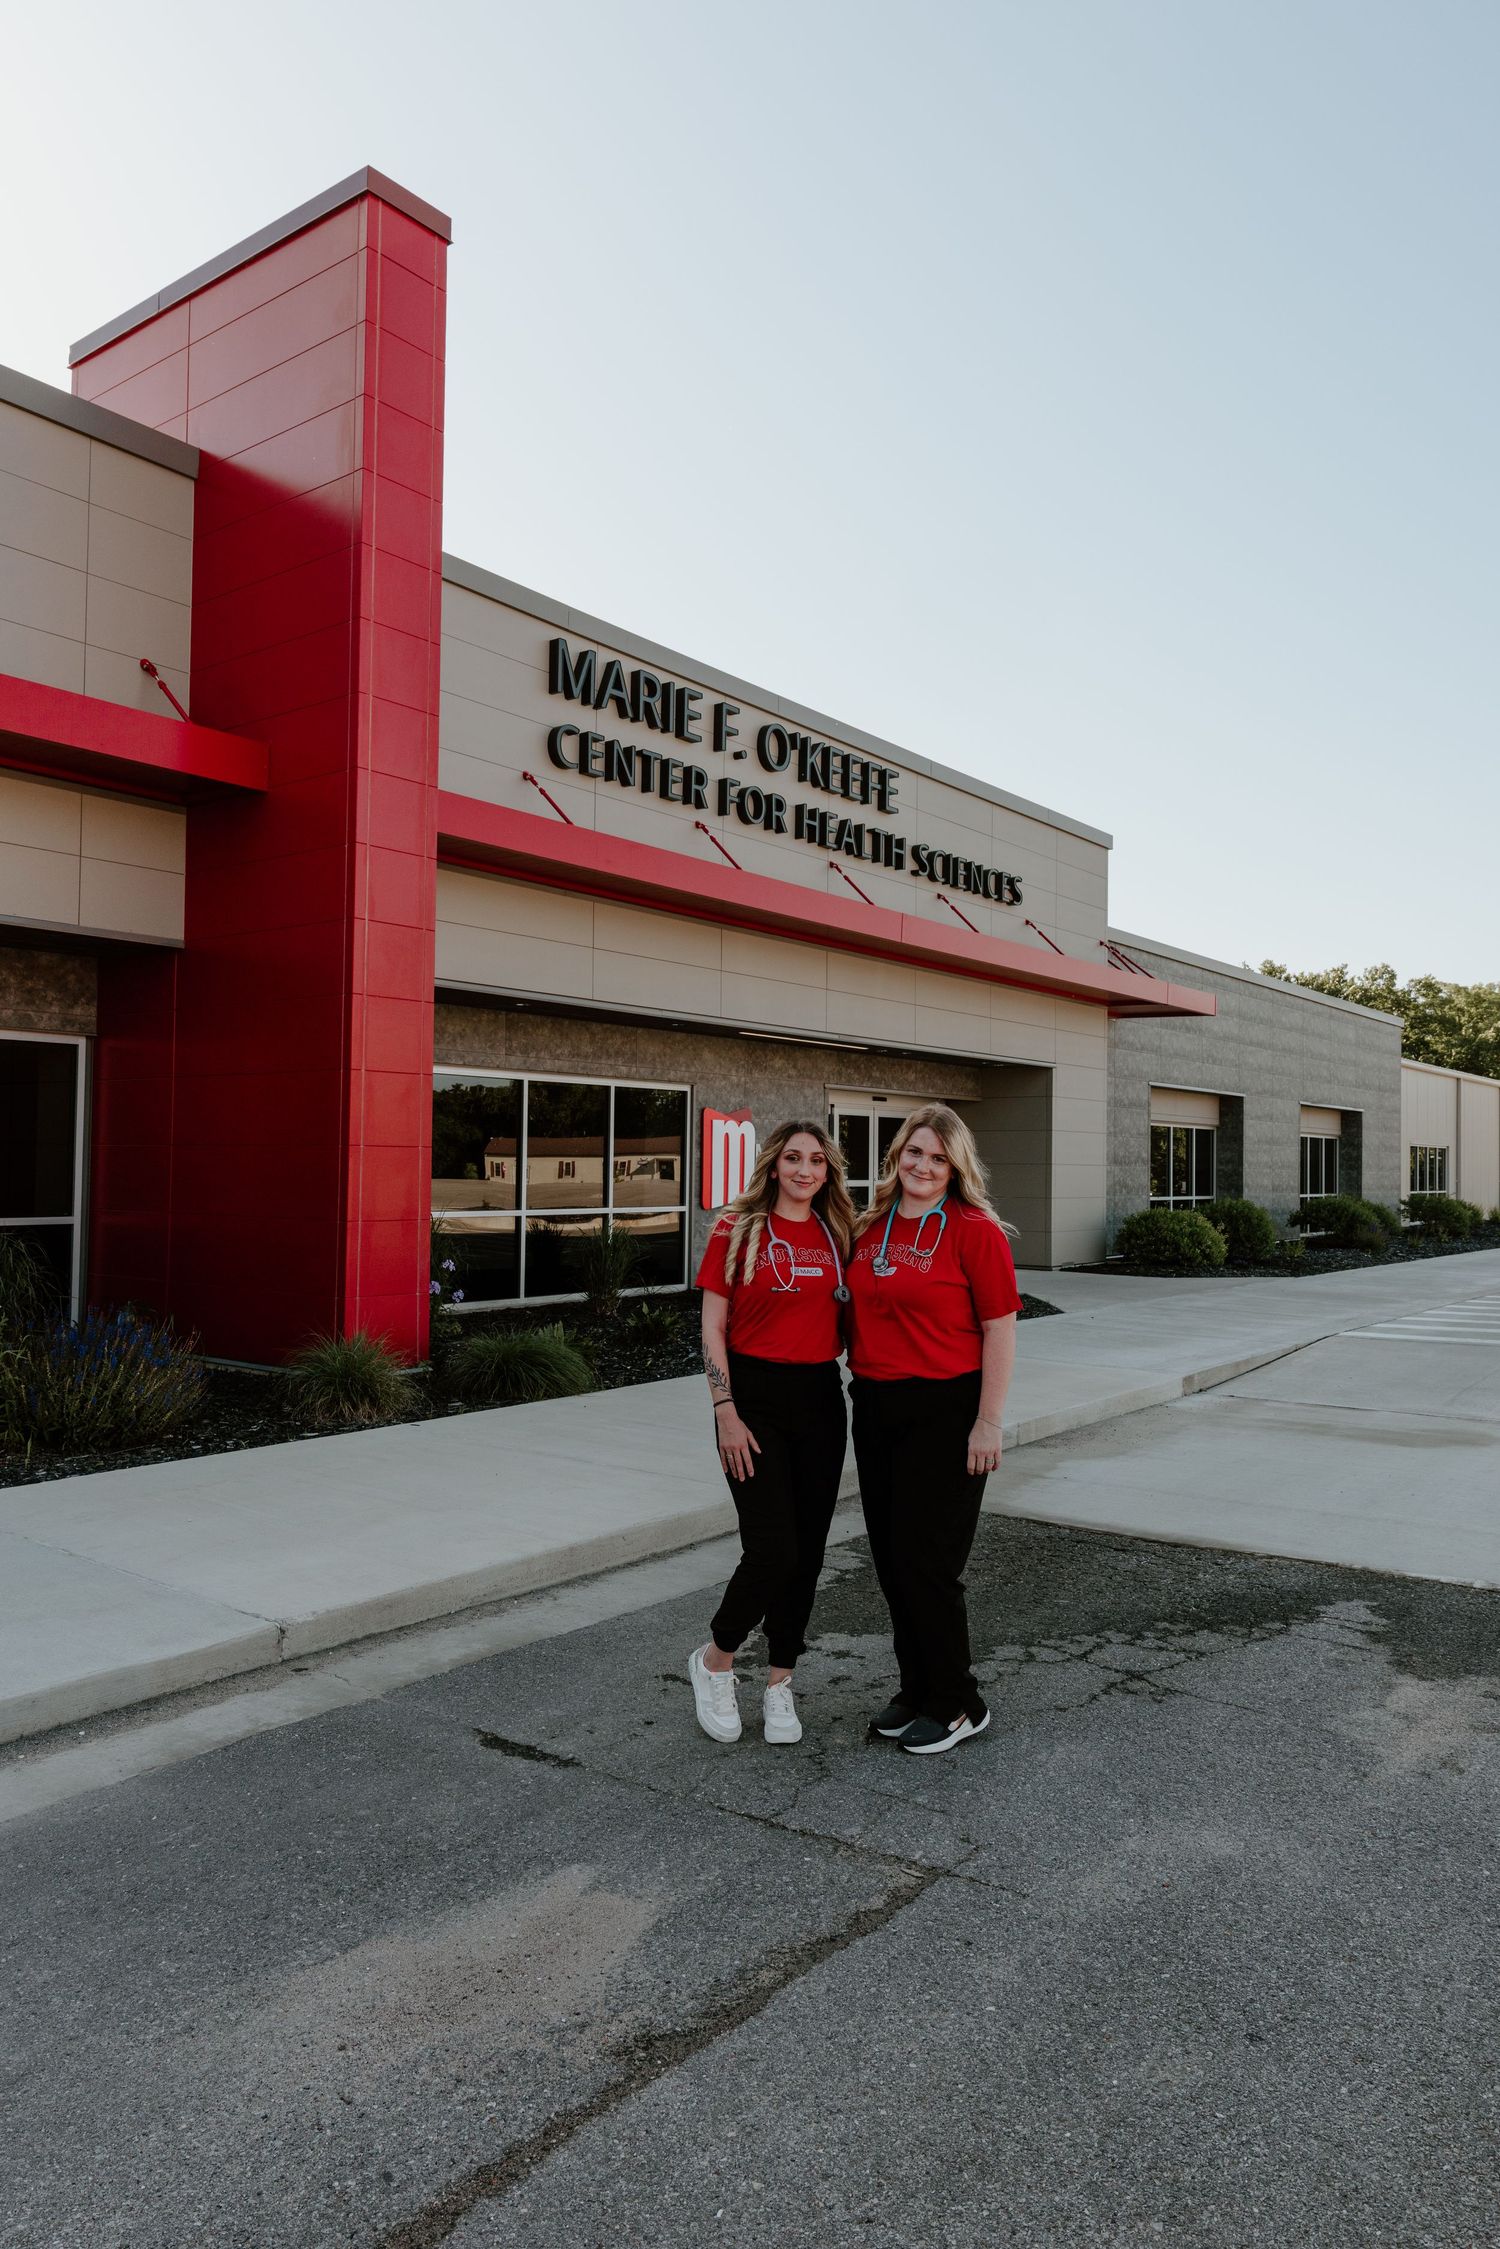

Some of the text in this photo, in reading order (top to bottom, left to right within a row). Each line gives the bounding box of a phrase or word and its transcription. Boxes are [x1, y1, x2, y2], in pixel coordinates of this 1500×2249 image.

[547, 724, 1024, 906] CENTER FOR HEALTH SCIENCES
[548, 637, 900, 815] MARIE F. O'KEEFE
[755, 1246, 837, 1270] NURSIN
